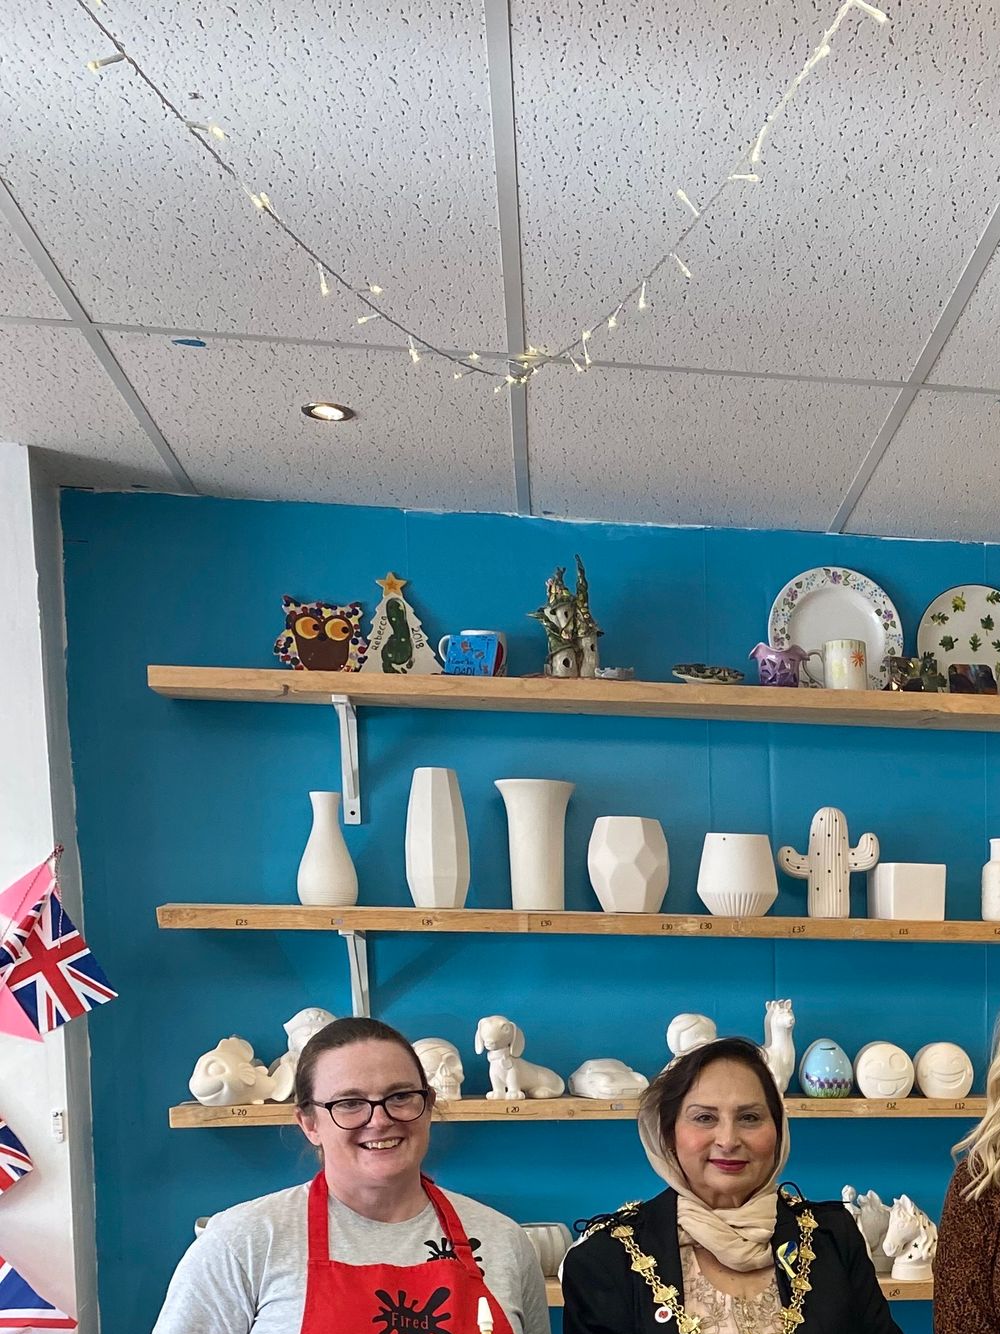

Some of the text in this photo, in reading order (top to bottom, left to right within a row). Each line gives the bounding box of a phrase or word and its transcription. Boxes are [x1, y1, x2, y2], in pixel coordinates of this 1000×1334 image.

[371, 615, 387, 651] Rebecca
[411, 627, 425, 650] 2018
[235, 918, 248, 926] £25
[700, 922, 712, 930] £30
[792, 925, 806, 933] £35
[391, 1312, 429, 1330] Fired
